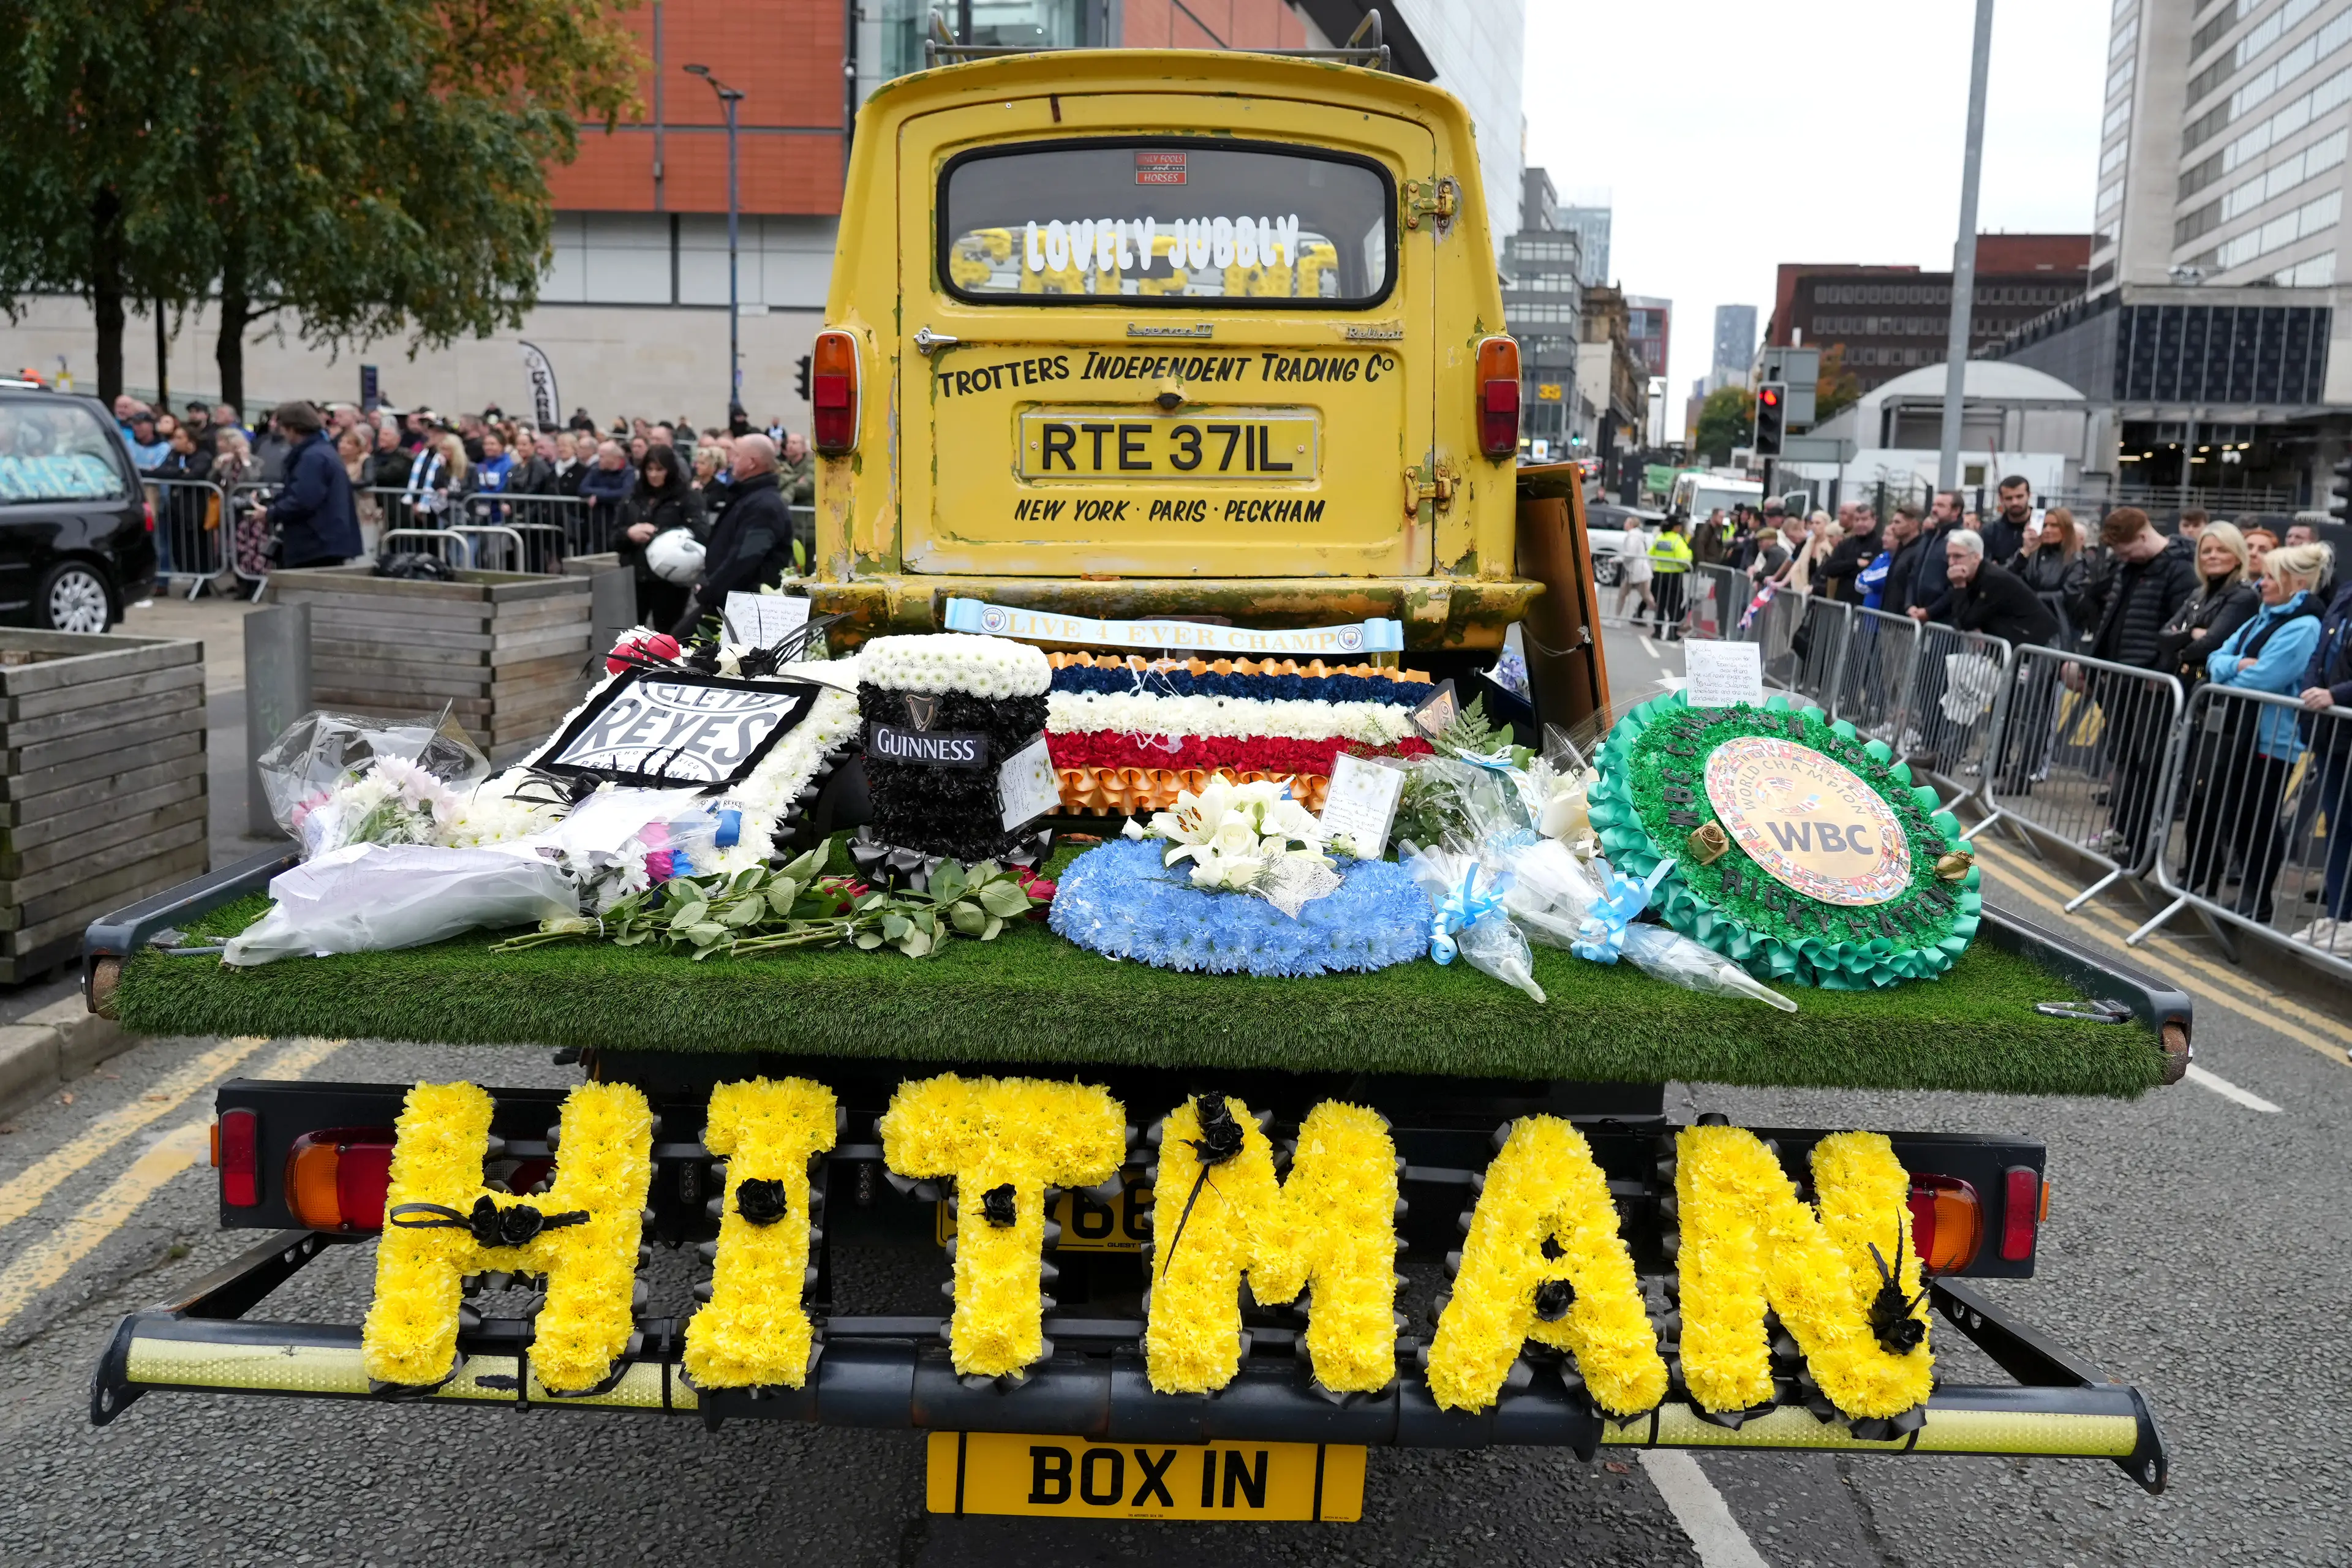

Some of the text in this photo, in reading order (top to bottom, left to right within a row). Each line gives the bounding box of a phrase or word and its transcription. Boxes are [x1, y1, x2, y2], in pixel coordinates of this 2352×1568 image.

[1144, 173, 1179, 183] HORSES
[1160, 154, 1183, 163] FOOLS
[1027, 216, 1156, 273] LOVELY
[1167, 213, 1300, 270] JUBBLY
[1348, 328, 1403, 339] Reliant
[938, 355, 1069, 398] TROTTERS
[1080, 351, 1252, 383] INDEPENDENT
[1261, 352, 1359, 383] TRADING
[1041, 423, 1294, 472] RTE 371L
[1014, 499, 1326, 523] NEW YORK PARIS PECKHAM
[1008, 612, 1337, 651] LIVE 4 EVER CHAMP
[657, 684, 769, 709] CLETO
[563, 698, 778, 765] REYES
[876, 728, 975, 761] GUINNESS
[664, 753, 699, 769] MXICO
[1662, 767, 1702, 827] WBC
[1740, 760, 1866, 814] WORLD CHAMPION
[1765, 821, 1874, 855] WBC
[1722, 868, 1956, 940] RICKY HATTON
[360, 1072, 1936, 1421] HITMAN
[1028, 1446, 1268, 1509] BOX IN
